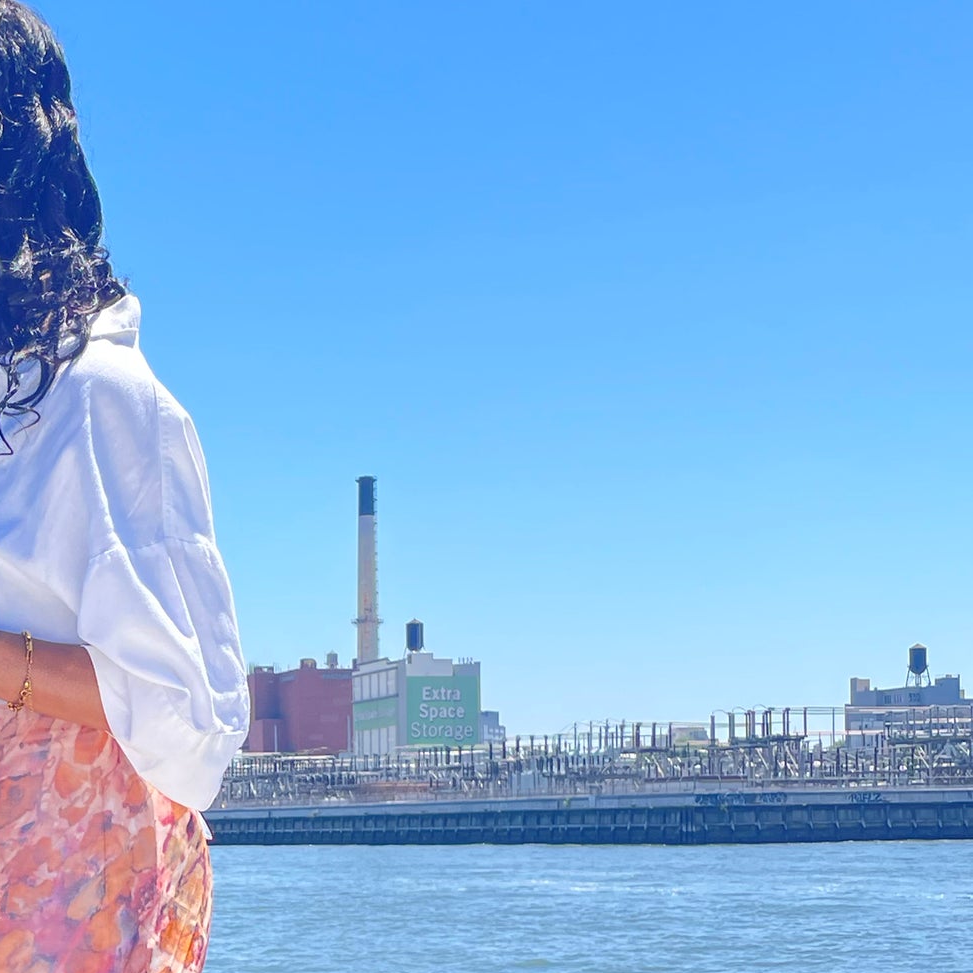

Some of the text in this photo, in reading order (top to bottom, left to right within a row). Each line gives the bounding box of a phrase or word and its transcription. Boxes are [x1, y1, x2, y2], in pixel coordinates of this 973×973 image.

[422, 687, 461, 700] Extra
[419, 703, 464, 721] Space
[411, 722, 473, 740] Storage
